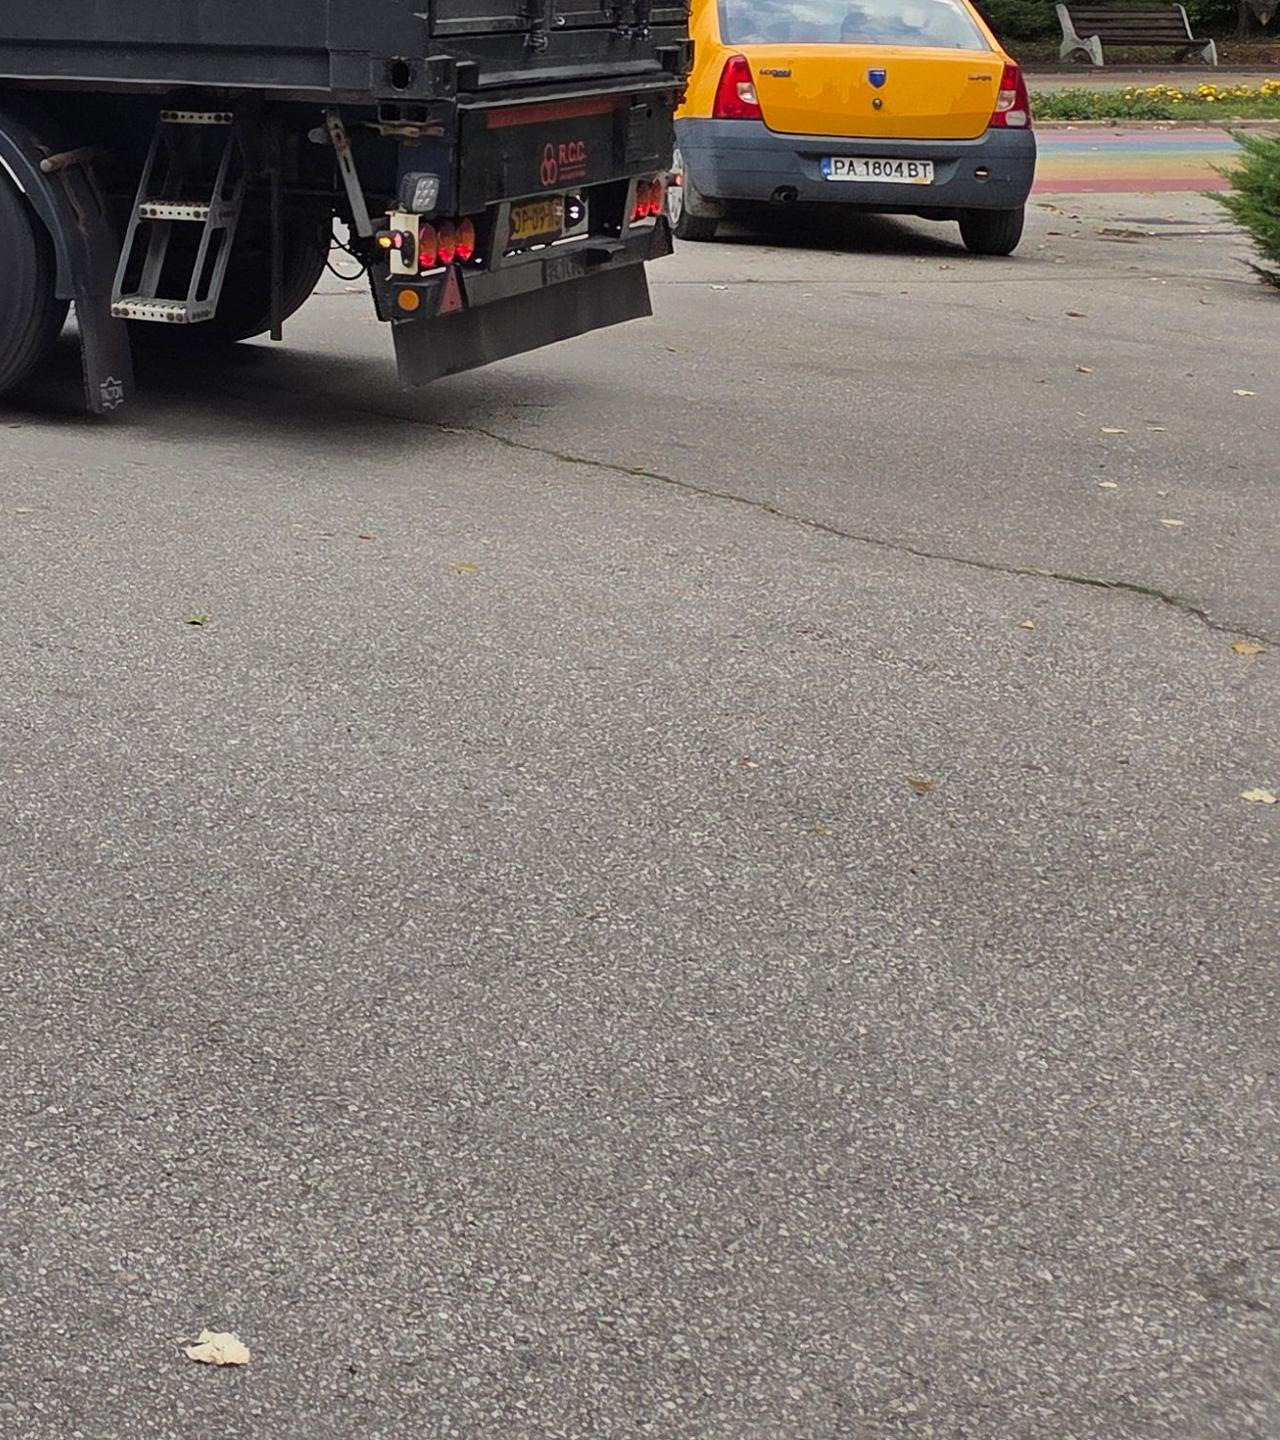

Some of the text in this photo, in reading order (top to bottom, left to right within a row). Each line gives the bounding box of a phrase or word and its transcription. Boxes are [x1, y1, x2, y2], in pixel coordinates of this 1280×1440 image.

[833, 159, 931, 179] PA 1804 BT
